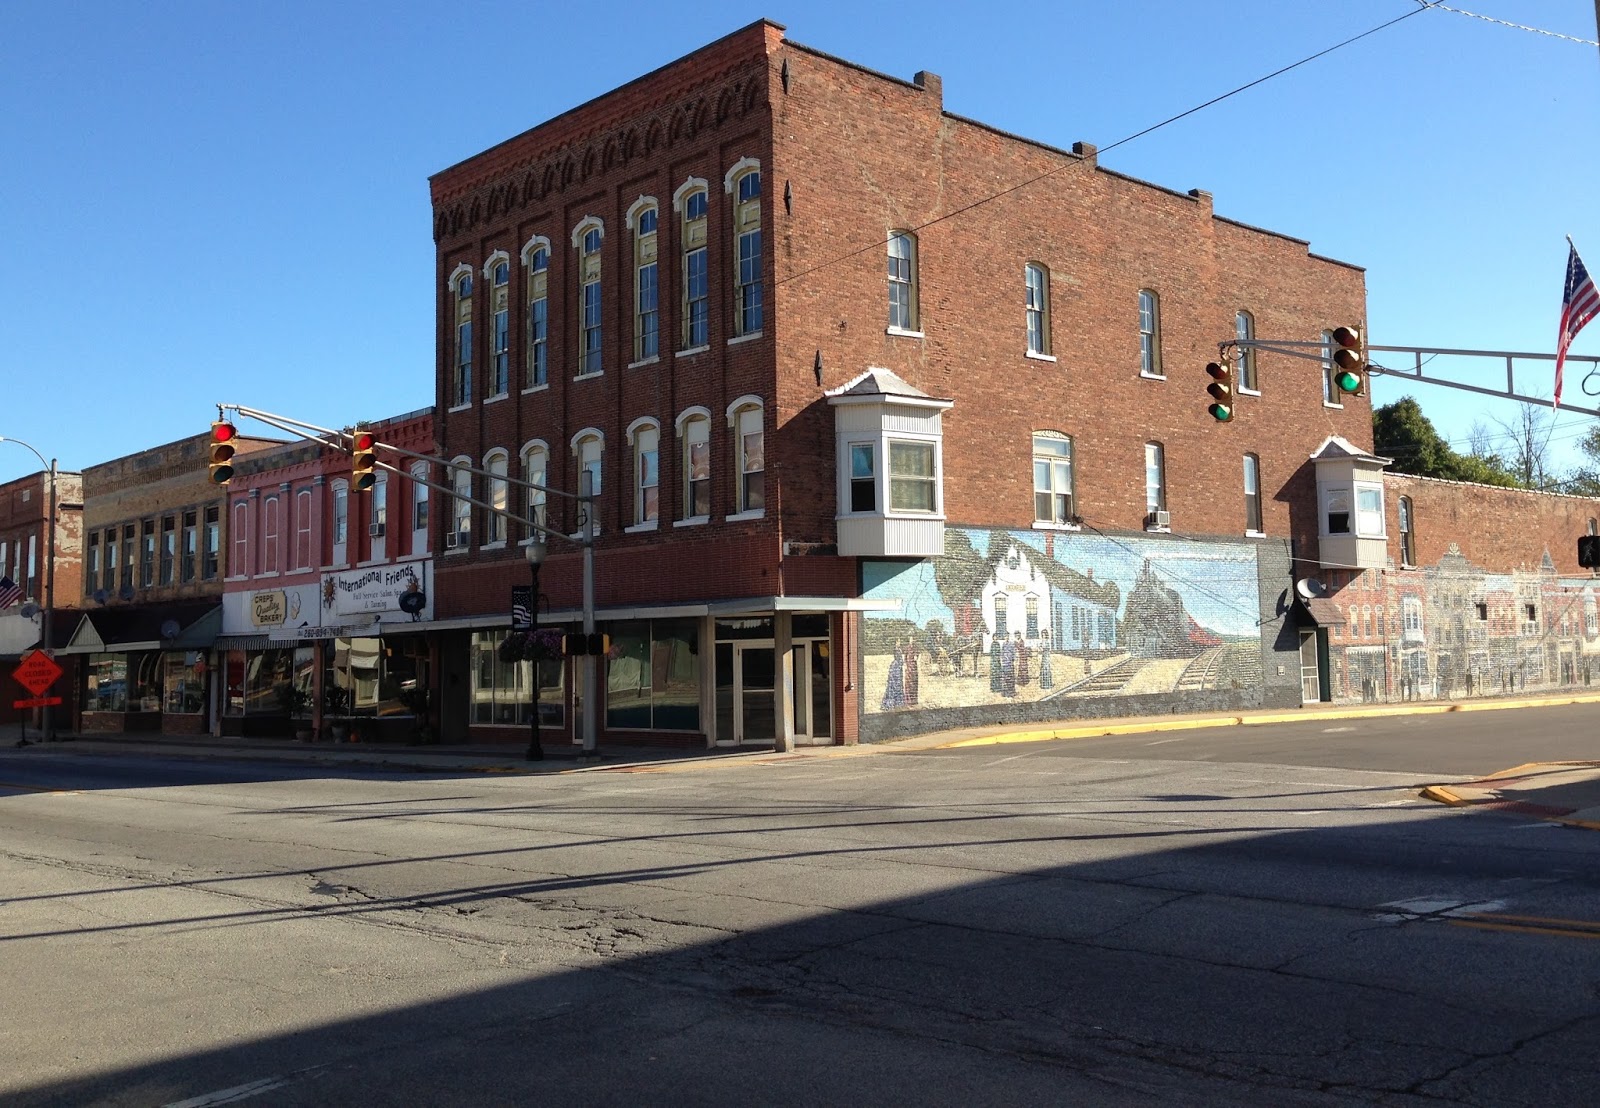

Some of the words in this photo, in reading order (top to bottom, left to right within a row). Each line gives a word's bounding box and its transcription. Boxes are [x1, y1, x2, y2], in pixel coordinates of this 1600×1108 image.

[338, 570, 382, 593] International
[352, 592, 362, 601] Full
[363, 591, 378, 600] Service
[256, 602, 280, 617] Quality
[370, 600, 387, 609] Tanning
[260, 613, 282, 623] BAKERY
[25, 670, 52, 678] CLOSED
